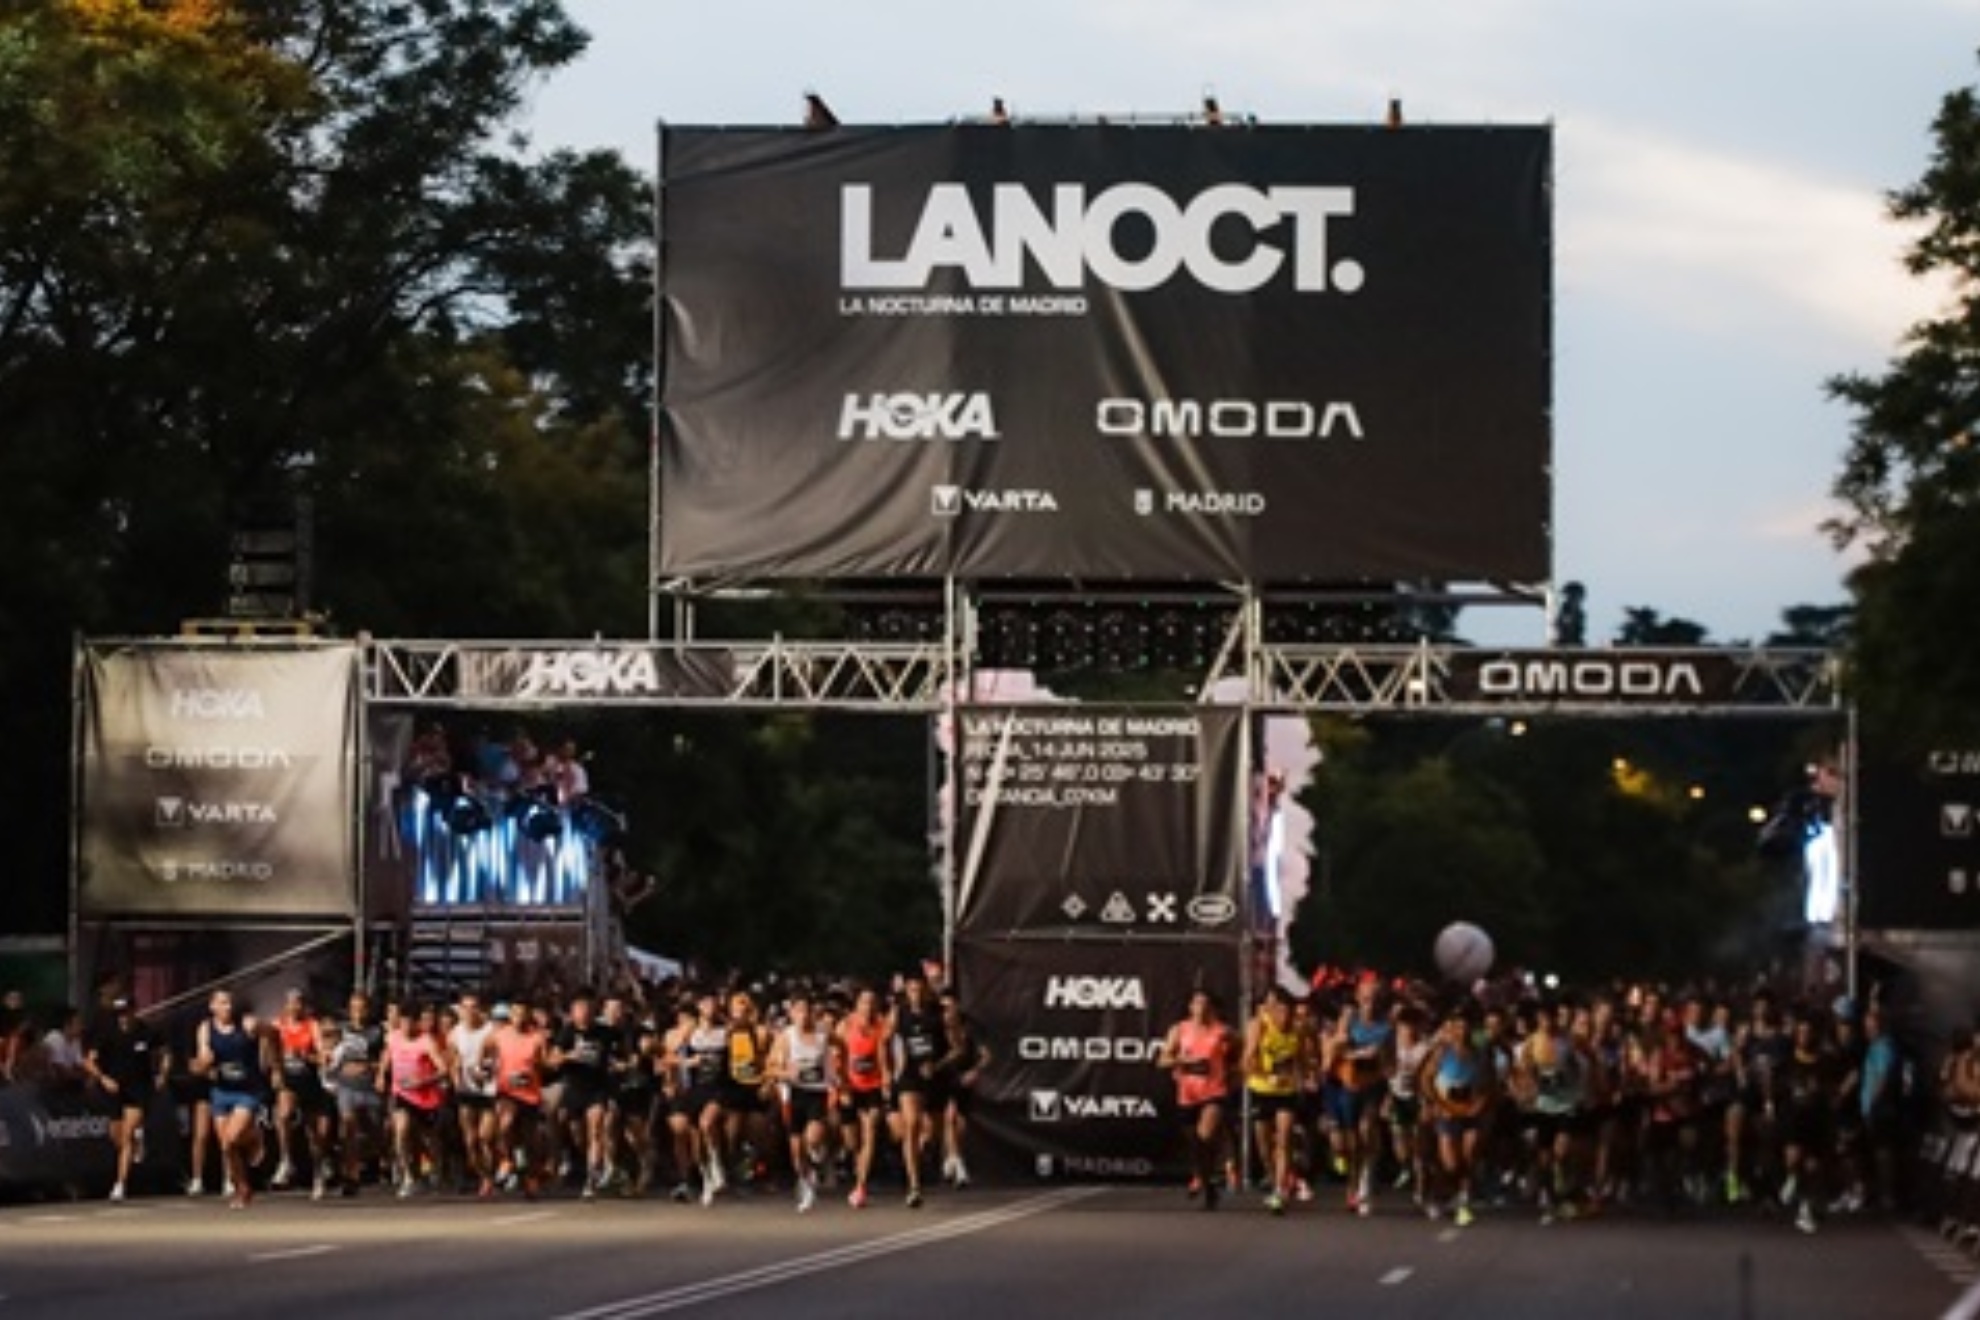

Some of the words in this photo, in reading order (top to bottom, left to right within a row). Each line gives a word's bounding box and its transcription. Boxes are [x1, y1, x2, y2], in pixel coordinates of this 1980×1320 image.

[840, 182, 1364, 292] LANOCT.
[840, 297, 863, 315] LA
[869, 297, 973, 315] NOCTURNA
[978, 297, 1002, 315] DE
[1010, 297, 1088, 315] MADRID
[838, 392, 1000, 440] HOKA
[1098, 398, 1364, 438] OMODA
[964, 489, 1058, 512] VARTA
[1166, 491, 1265, 516] MADRID
[517, 651, 660, 697] HOKA
[1478, 661, 1702, 695] OMODA
[172, 687, 265, 720] HOKA
[1098, 717, 1121, 735] DE
[1126, 717, 1200, 735] MADRID
[148, 748, 291, 769] OMODA
[188, 803, 277, 823] VARTA
[187, 861, 274, 882] MADRID
[1044, 976, 1146, 1009] HOKA
[1064, 1096, 1157, 1118] VARTA
[1064, 1157, 1151, 1176] MADRID
